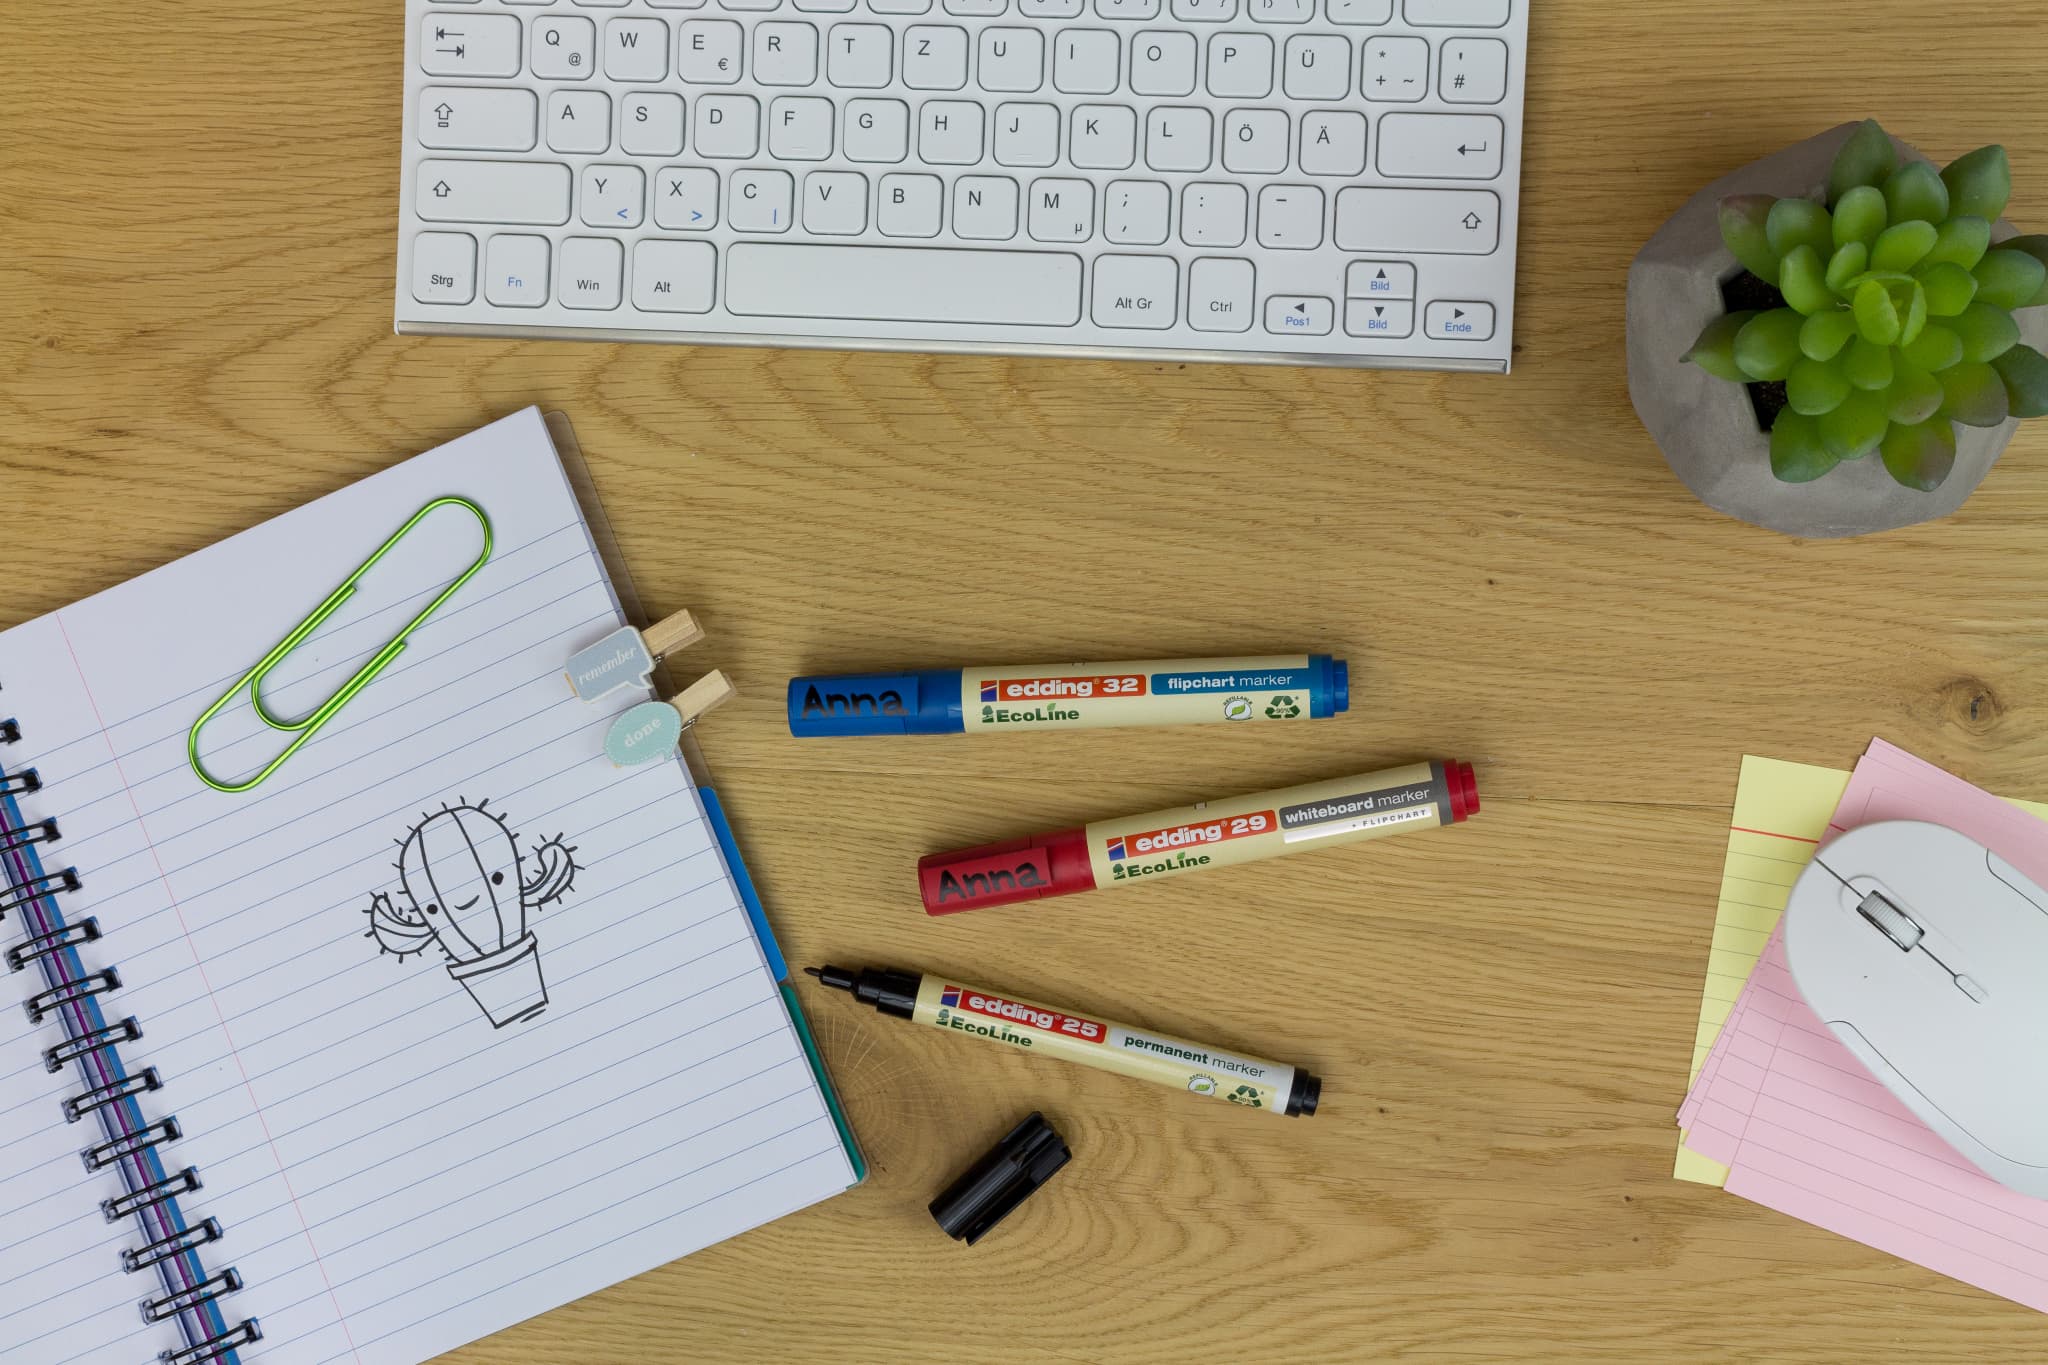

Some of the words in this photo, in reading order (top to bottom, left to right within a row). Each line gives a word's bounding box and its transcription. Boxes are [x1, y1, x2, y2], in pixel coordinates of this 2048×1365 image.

[545, 29, 560, 47] Q
[619, 31, 639, 49] W
[692, 34, 705, 51] E
[767, 35, 781, 53] R
[843, 37, 856, 54] T
[917, 39, 931, 56] Z
[993, 40, 1007, 58] U
[1069, 43, 1074, 60] I
[1146, 45, 1162, 62] O
[1223, 47, 1237, 64] P
[1301, 49, 1315, 68] Ü
[561, 104, 575, 121] A
[635, 105, 648, 122] S
[709, 108, 723, 125] D
[784, 110, 796, 127] F
[858, 112, 873, 129] G
[934, 114, 948, 131] H
[1009, 117, 1019, 134] J
[1086, 119, 1099, 136] K
[1162, 121, 1173, 138] L
[1238, 123, 1254, 143] Ö
[1316, 125, 1331, 145] Ä
[594, 178, 608, 194] Y
[669, 180, 683, 197] X
[743, 183, 757, 200] C
[818, 185, 833, 201] V
[892, 187, 905, 204] B
[968, 190, 982, 207] N
[1044, 192, 1060, 209] M
[430, 273, 454, 288] Strg
[507, 276, 522, 288] Fn
[576, 279, 600, 291] Win
[653, 281, 671, 293] Alt
[1370, 280, 1390, 291] Bild
[1114, 296, 1132, 309] Alt
[1136, 297, 1153, 310] Gr
[1209, 300, 1233, 313] Ctrl
[1285, 315, 1310, 327] Pos1
[1368, 319, 1388, 330] Bild
[1444, 321, 1472, 333] Ende
[578, 646, 636, 686] remember
[1103, 677, 1138, 693] 32
[1168, 676, 1235, 691] flipchart
[1239, 675, 1293, 687] marker
[802, 684, 910, 719] Anna
[996, 703, 1080, 723] EcoLine
[624, 717, 662, 748] done
[1285, 797, 1374, 824] whiteboard
[1378, 788, 1430, 809] marker
[1231, 815, 1267, 835] 29
[1362, 809, 1426, 827] FLIPCHART
[1127, 852, 1211, 878] EcoLine
[939, 862, 1048, 903] Anna
[950, 1015, 1032, 1047] EcoLine
[1062, 1018, 1098, 1038] 25
[1124, 1035, 1208, 1065] permanent
[1212, 1056, 1265, 1079] marker
